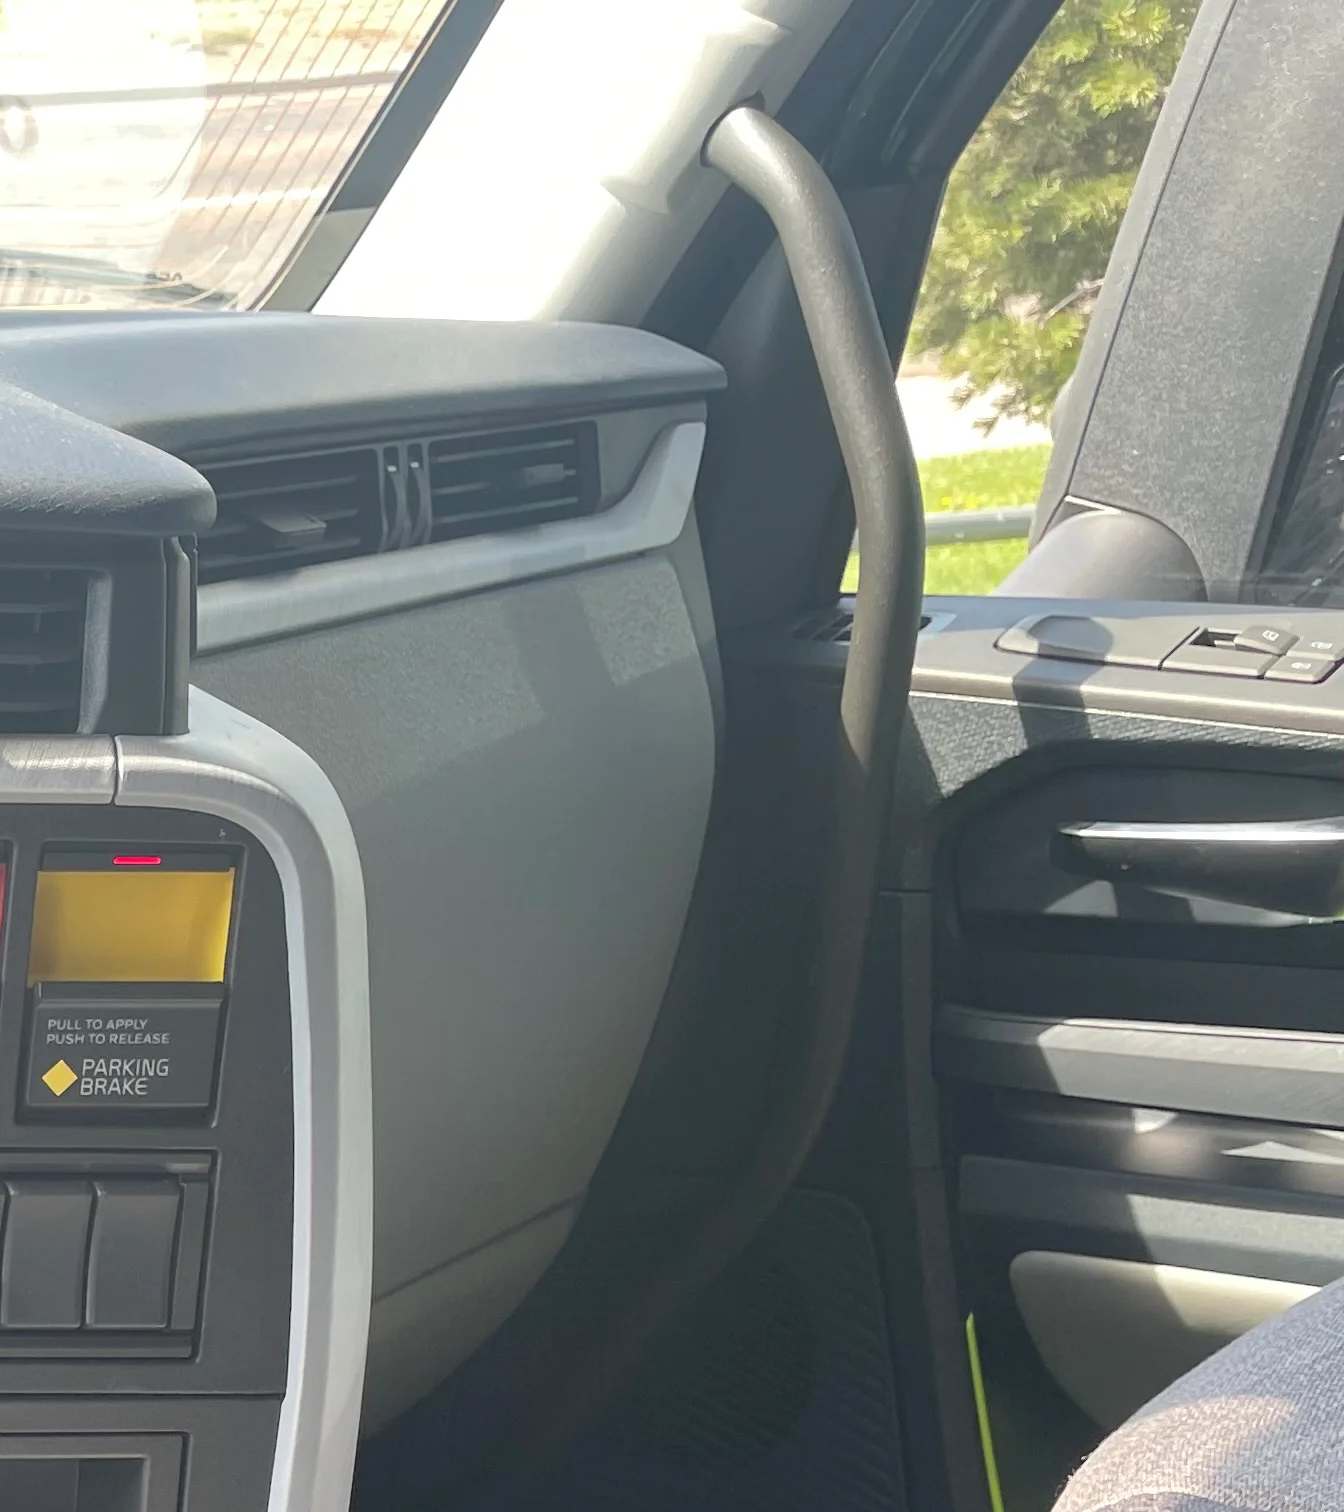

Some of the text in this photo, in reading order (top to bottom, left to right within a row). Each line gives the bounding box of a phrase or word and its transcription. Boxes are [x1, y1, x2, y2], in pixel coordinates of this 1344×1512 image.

[47, 1018, 149, 1031] PULL TO APPLY
[46, 1032, 172, 1045] PUSH TO RELEASE
[81, 1058, 170, 1077] PARKING
[79, 1077, 149, 1096] BRAKE
